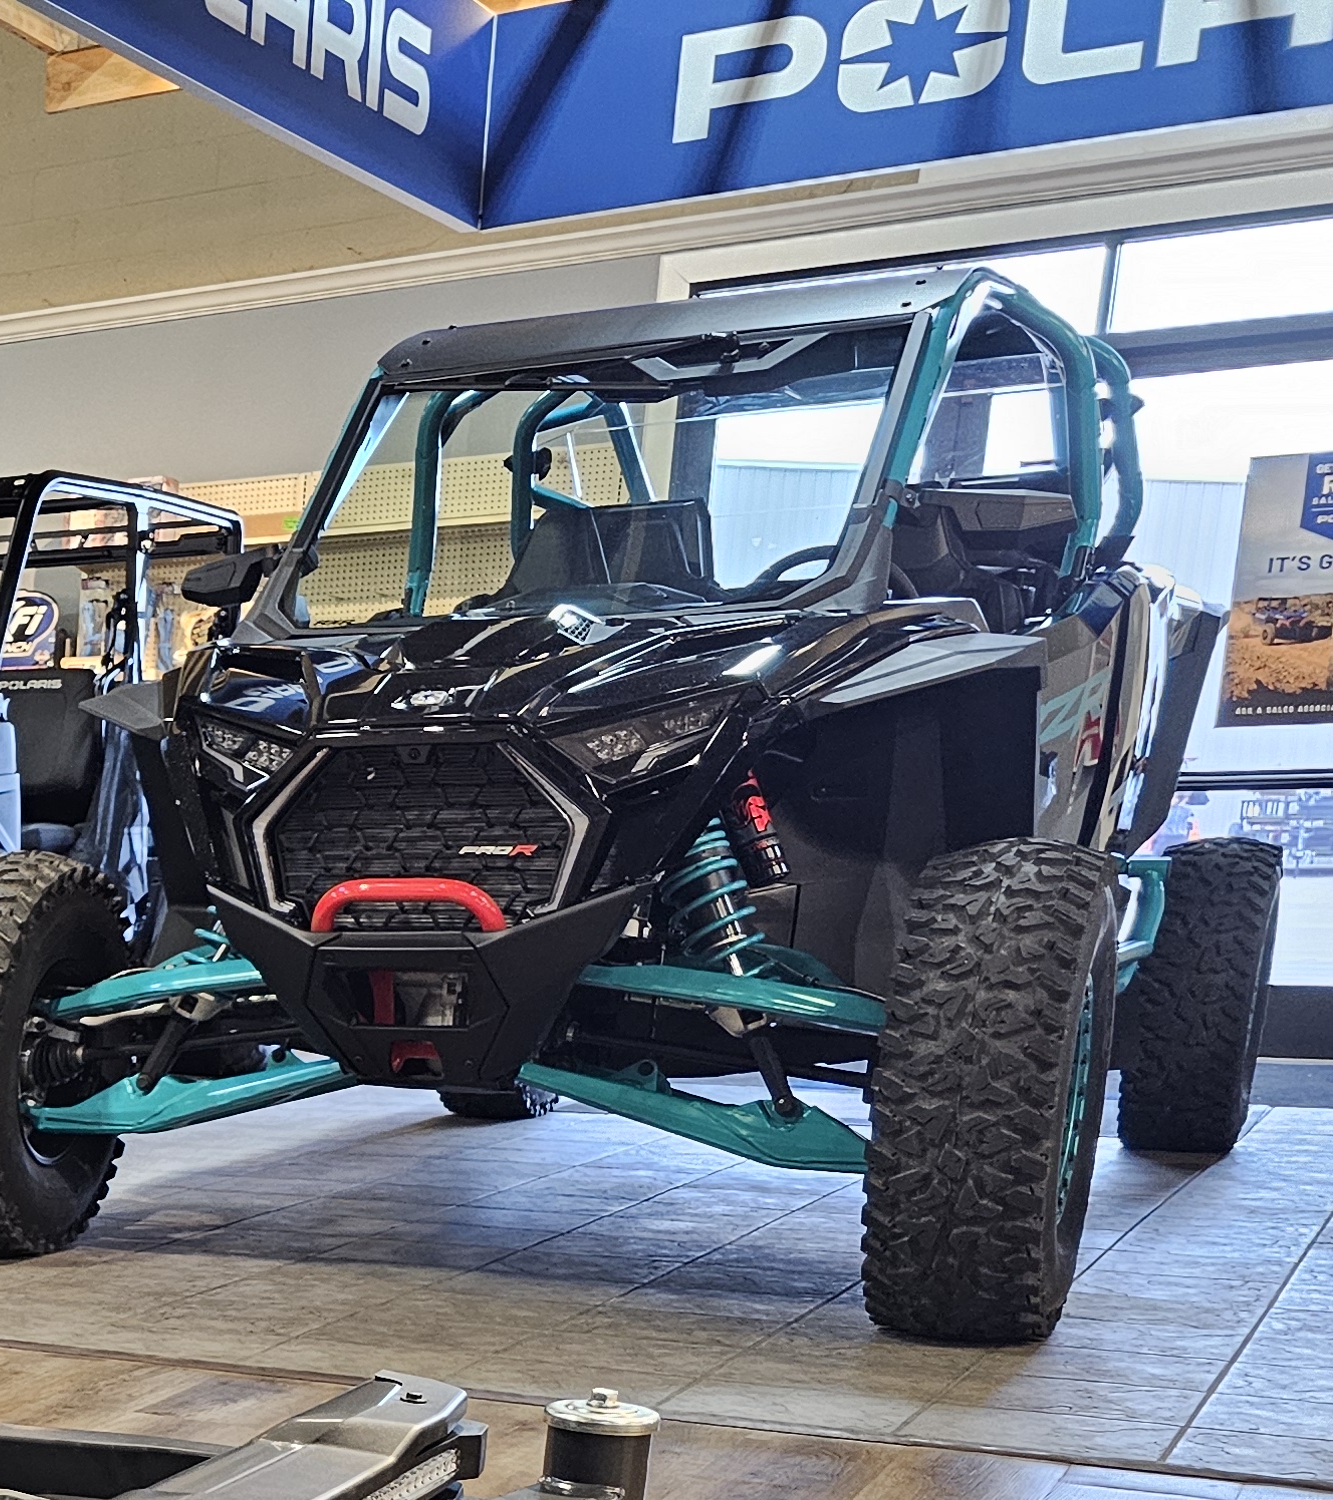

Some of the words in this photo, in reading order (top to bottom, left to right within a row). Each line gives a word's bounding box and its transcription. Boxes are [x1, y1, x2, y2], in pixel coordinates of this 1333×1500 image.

[1267, 555, 1312, 573] IT'S
[4, 641, 33, 653] NCH
[1039, 667, 1113, 746] ZR
